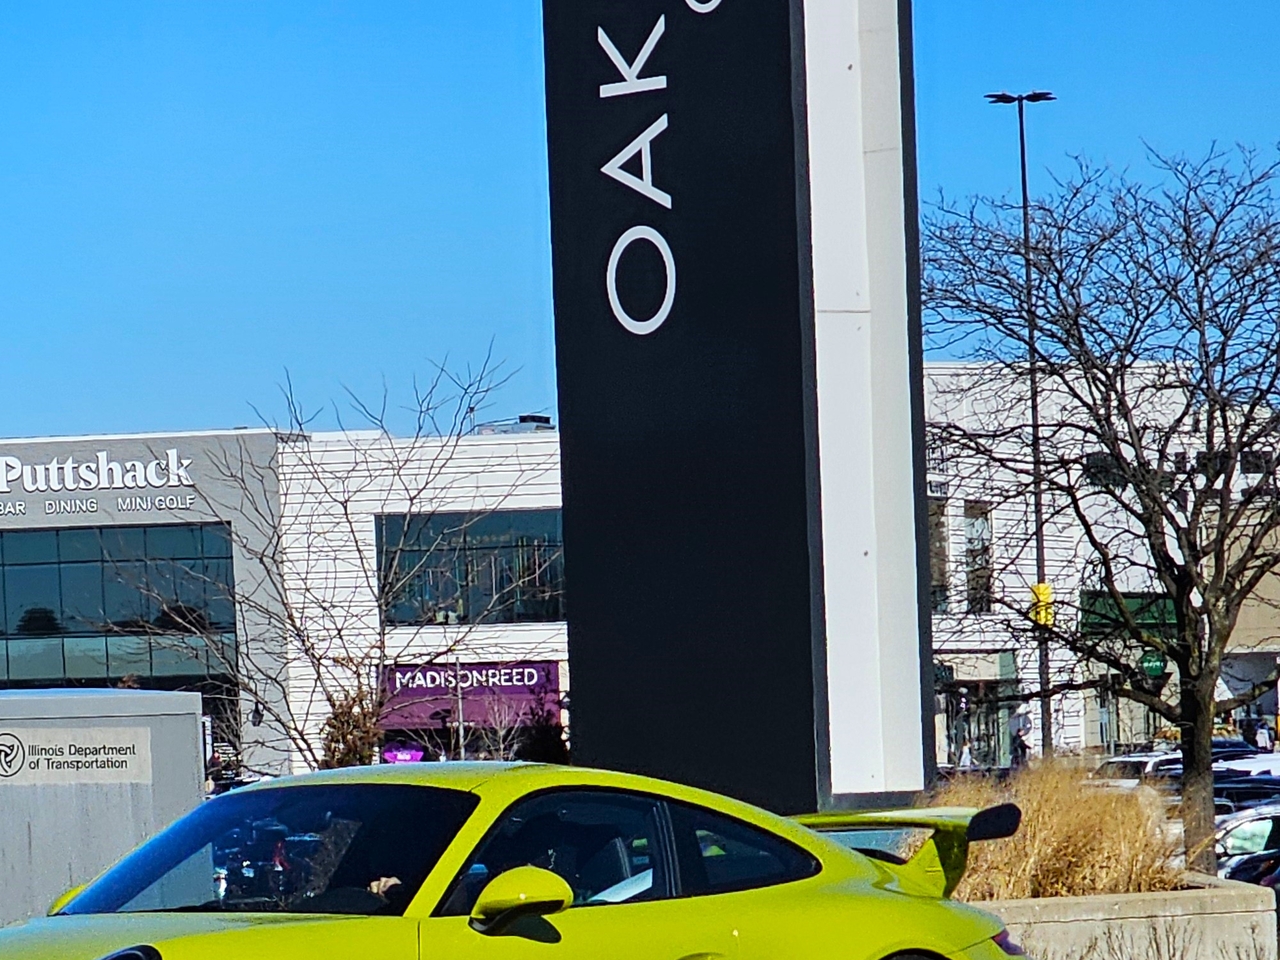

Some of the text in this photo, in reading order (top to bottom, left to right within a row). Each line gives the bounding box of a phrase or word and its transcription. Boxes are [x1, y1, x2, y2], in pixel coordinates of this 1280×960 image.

[597, 13, 676, 336] OAK
[45, 498, 98, 514] DINING
[28, 744, 137, 758] Illinois Department
[28, 758, 128, 771] of Transportation
